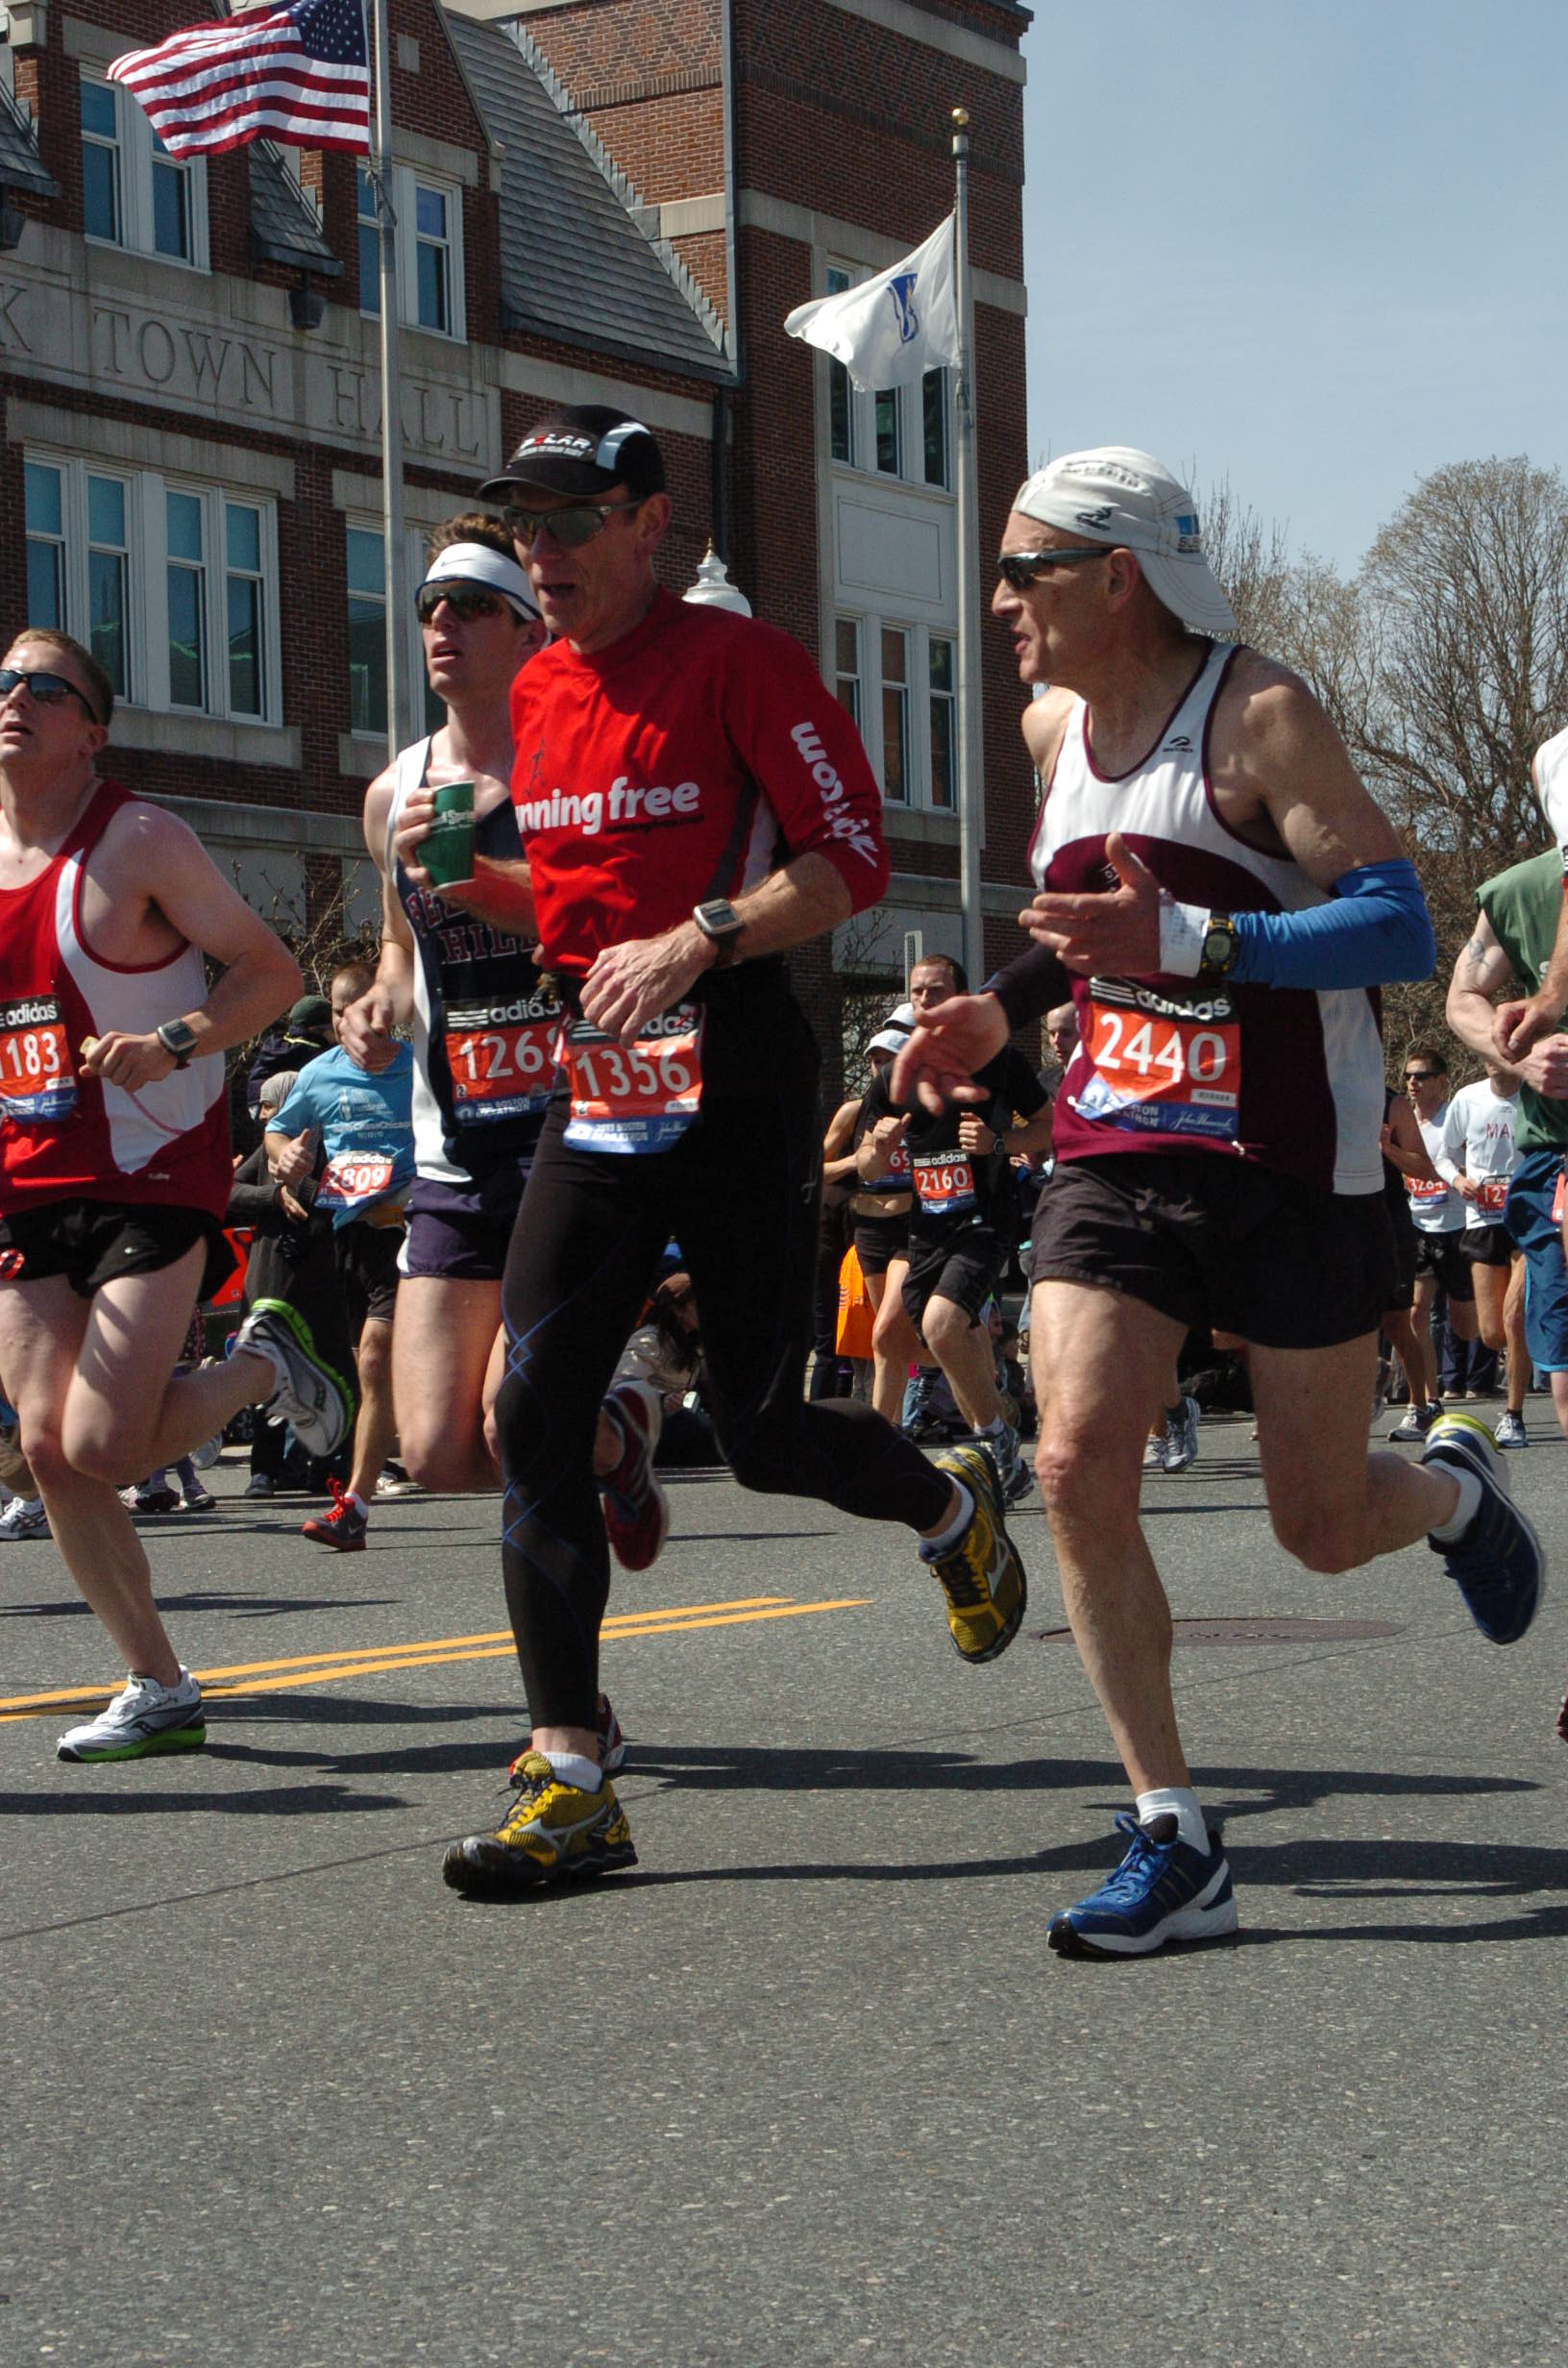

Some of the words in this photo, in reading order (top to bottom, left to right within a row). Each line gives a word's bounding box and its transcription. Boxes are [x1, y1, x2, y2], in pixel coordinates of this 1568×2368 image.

[94, 306, 278, 409] TOWN
[608, 776, 700, 821] free
[6, 1001, 58, 1026] adidas
[0, 1031, 61, 1080] 183
[1094, 1012, 1227, 1083] 2440
[576, 1046, 691, 1098] 1356
[918, 1167, 968, 1191] 2160
[931, 1153, 968, 1166] adidas
